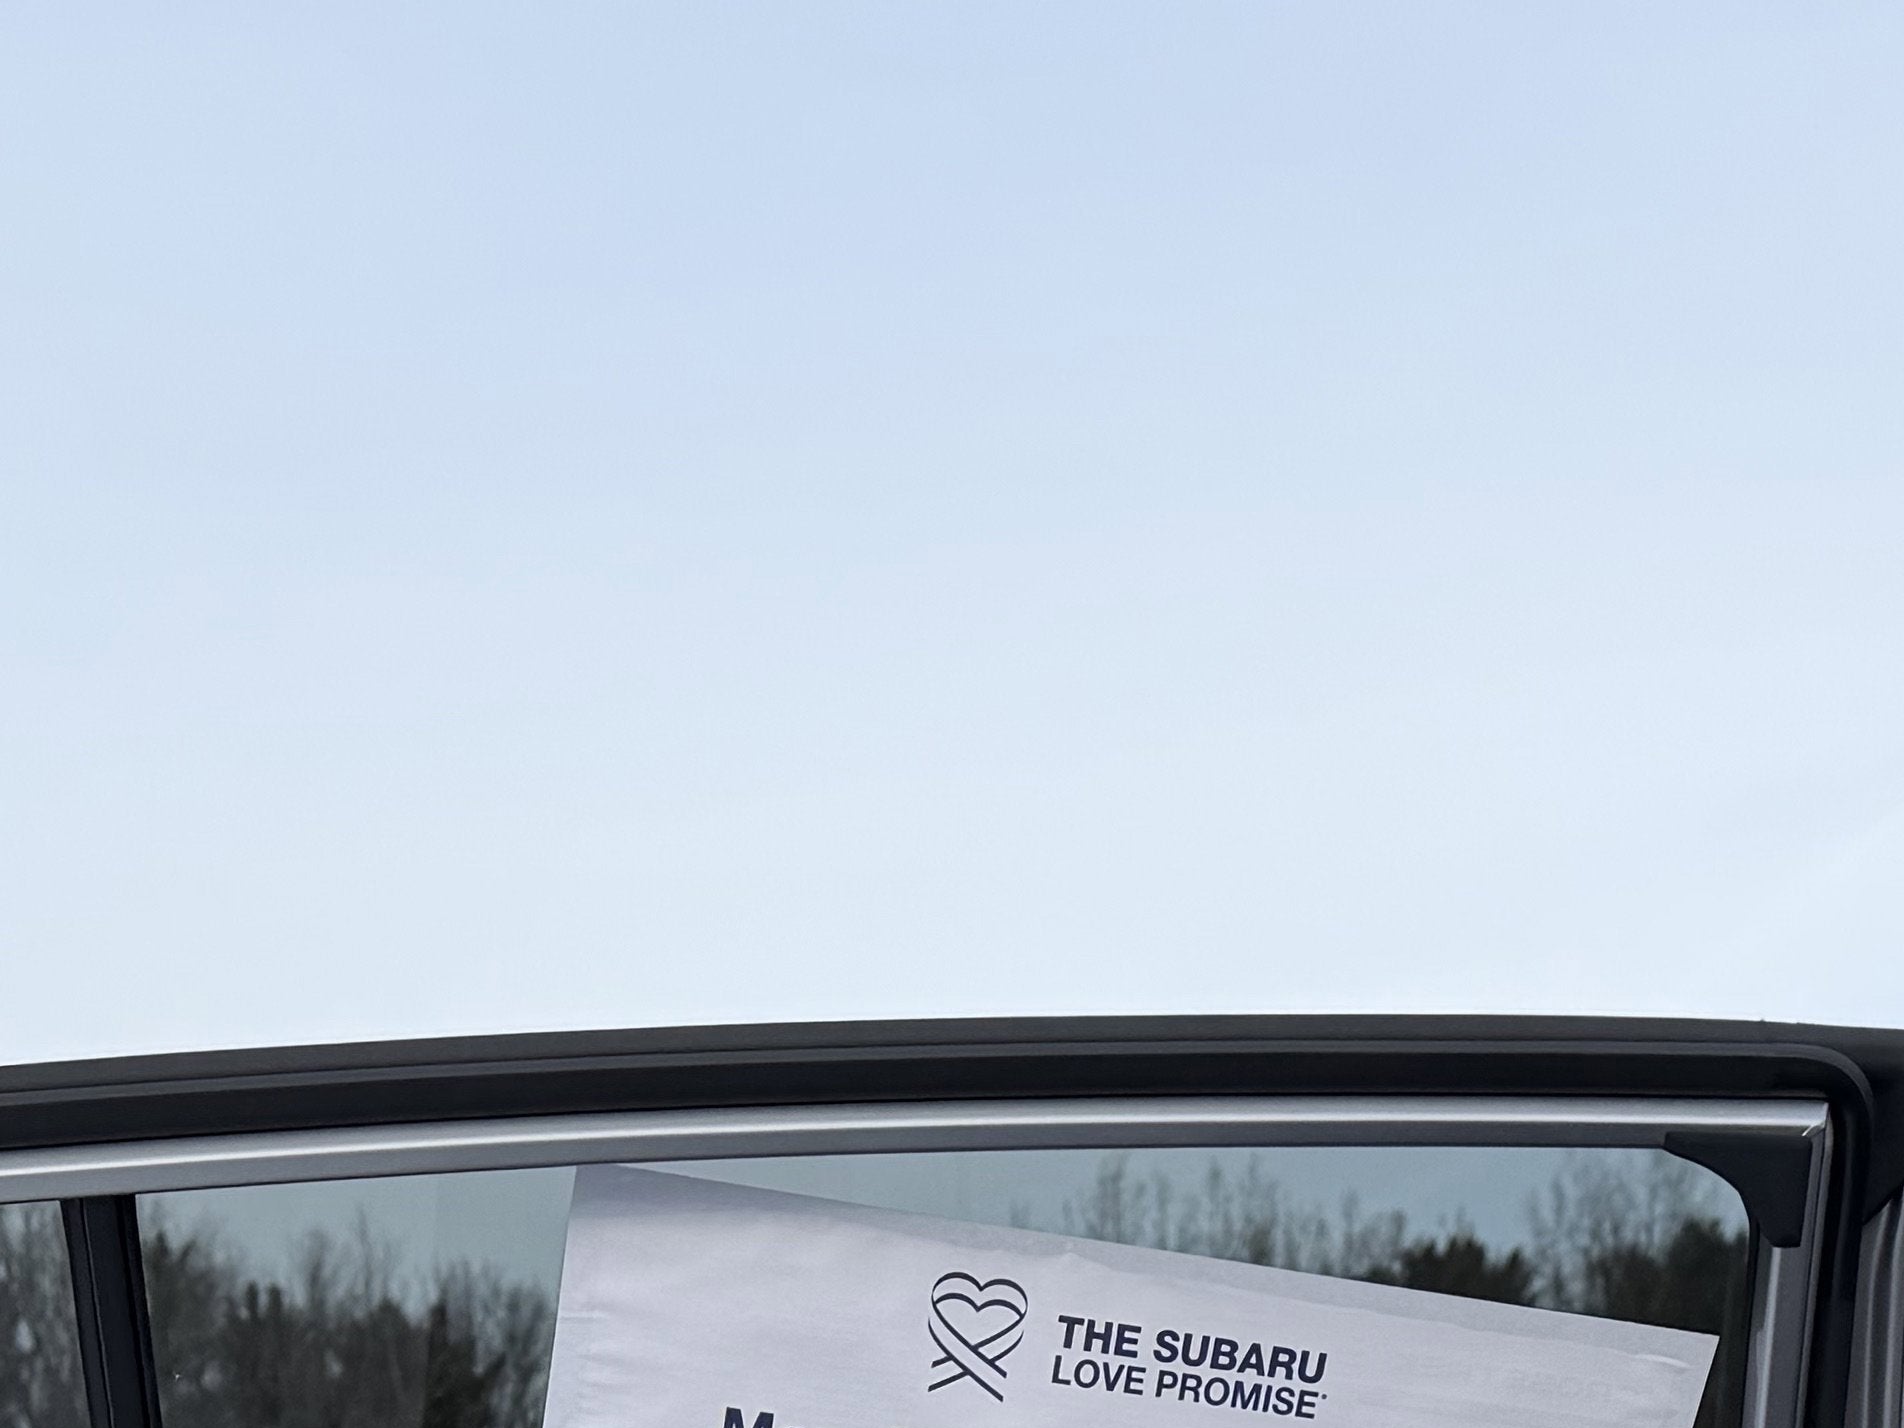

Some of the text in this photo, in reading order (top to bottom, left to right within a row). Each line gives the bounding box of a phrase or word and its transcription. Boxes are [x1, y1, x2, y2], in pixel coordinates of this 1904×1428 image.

[1051, 1354, 1147, 1396] LOVE
[1057, 1314, 1327, 1384] THE SUBARU
